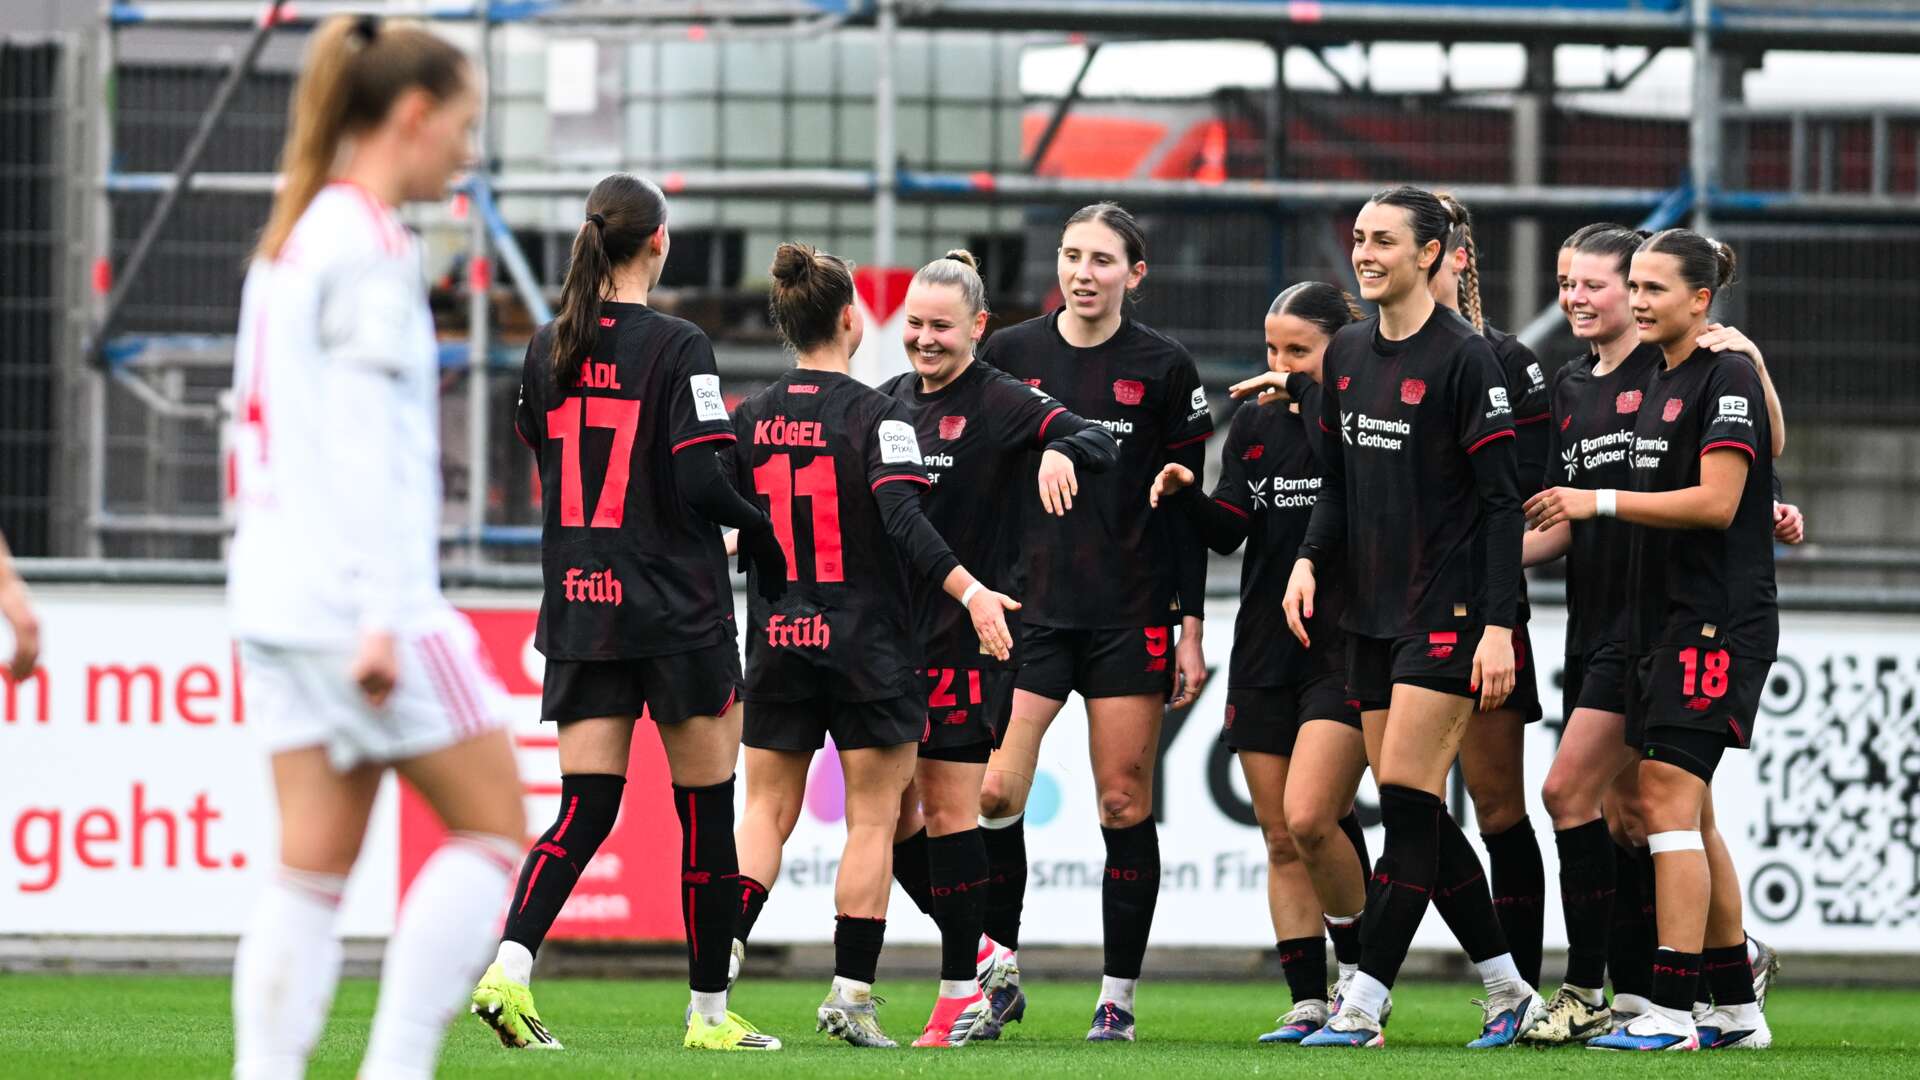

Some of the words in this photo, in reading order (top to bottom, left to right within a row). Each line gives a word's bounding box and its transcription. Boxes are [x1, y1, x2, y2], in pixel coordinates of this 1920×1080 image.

[576, 356, 622, 390] ÄDL
[1723, 401, 1746, 411] s2
[753, 415, 827, 447] KÖGEL
[1358, 414, 1410, 434] Barmenia
[1358, 431, 1402, 450] Gothaer
[1584, 449, 1626, 470] Gothaer
[1635, 436, 1668, 451] Barmenia
[547, 396, 641, 528] 17
[753, 453, 844, 583] 11
[563, 567, 623, 606] früh
[766, 613, 830, 650] früh
[927, 667, 982, 708] 21
[1679, 646, 1730, 698] 18
[12, 779, 248, 893] geht.
